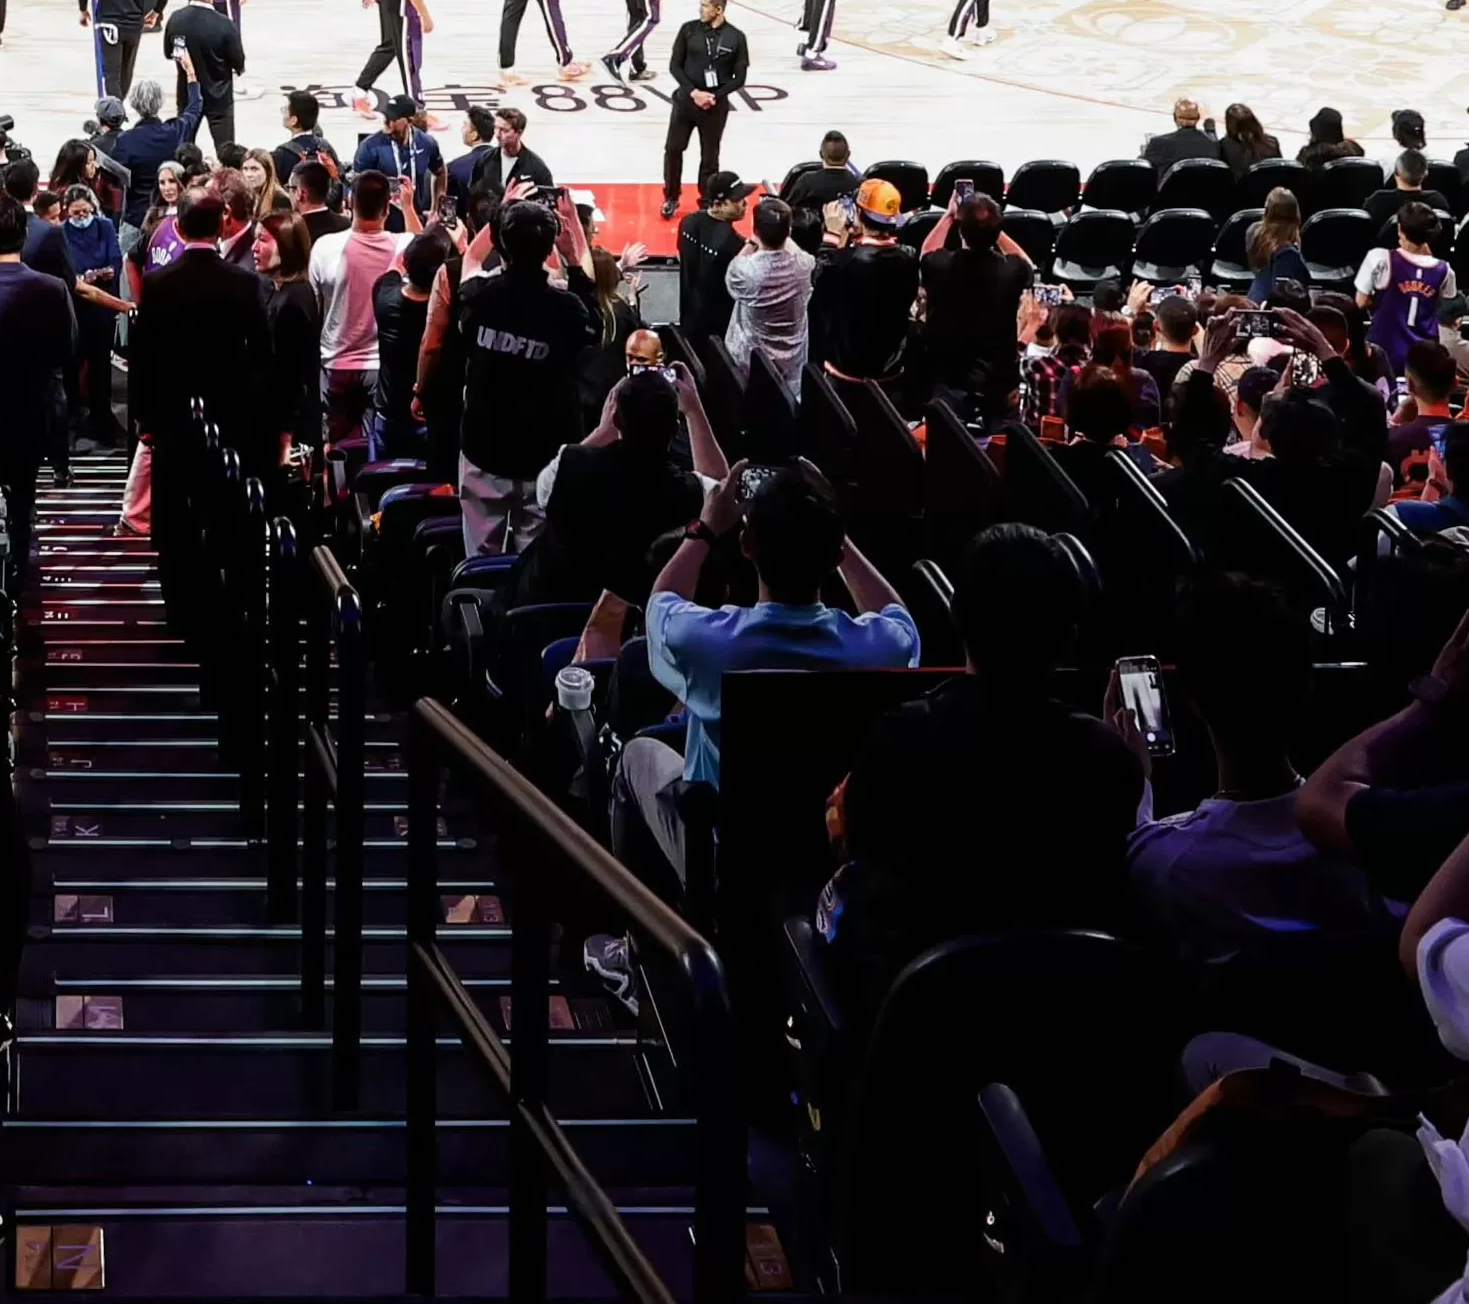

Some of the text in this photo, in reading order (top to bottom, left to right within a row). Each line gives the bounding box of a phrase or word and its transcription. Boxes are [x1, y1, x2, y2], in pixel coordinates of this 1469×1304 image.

[1397, 279, 1435, 299] BOOKER
[1407, 296, 1420, 328] 1
[476, 325, 550, 361] UNDFTD
